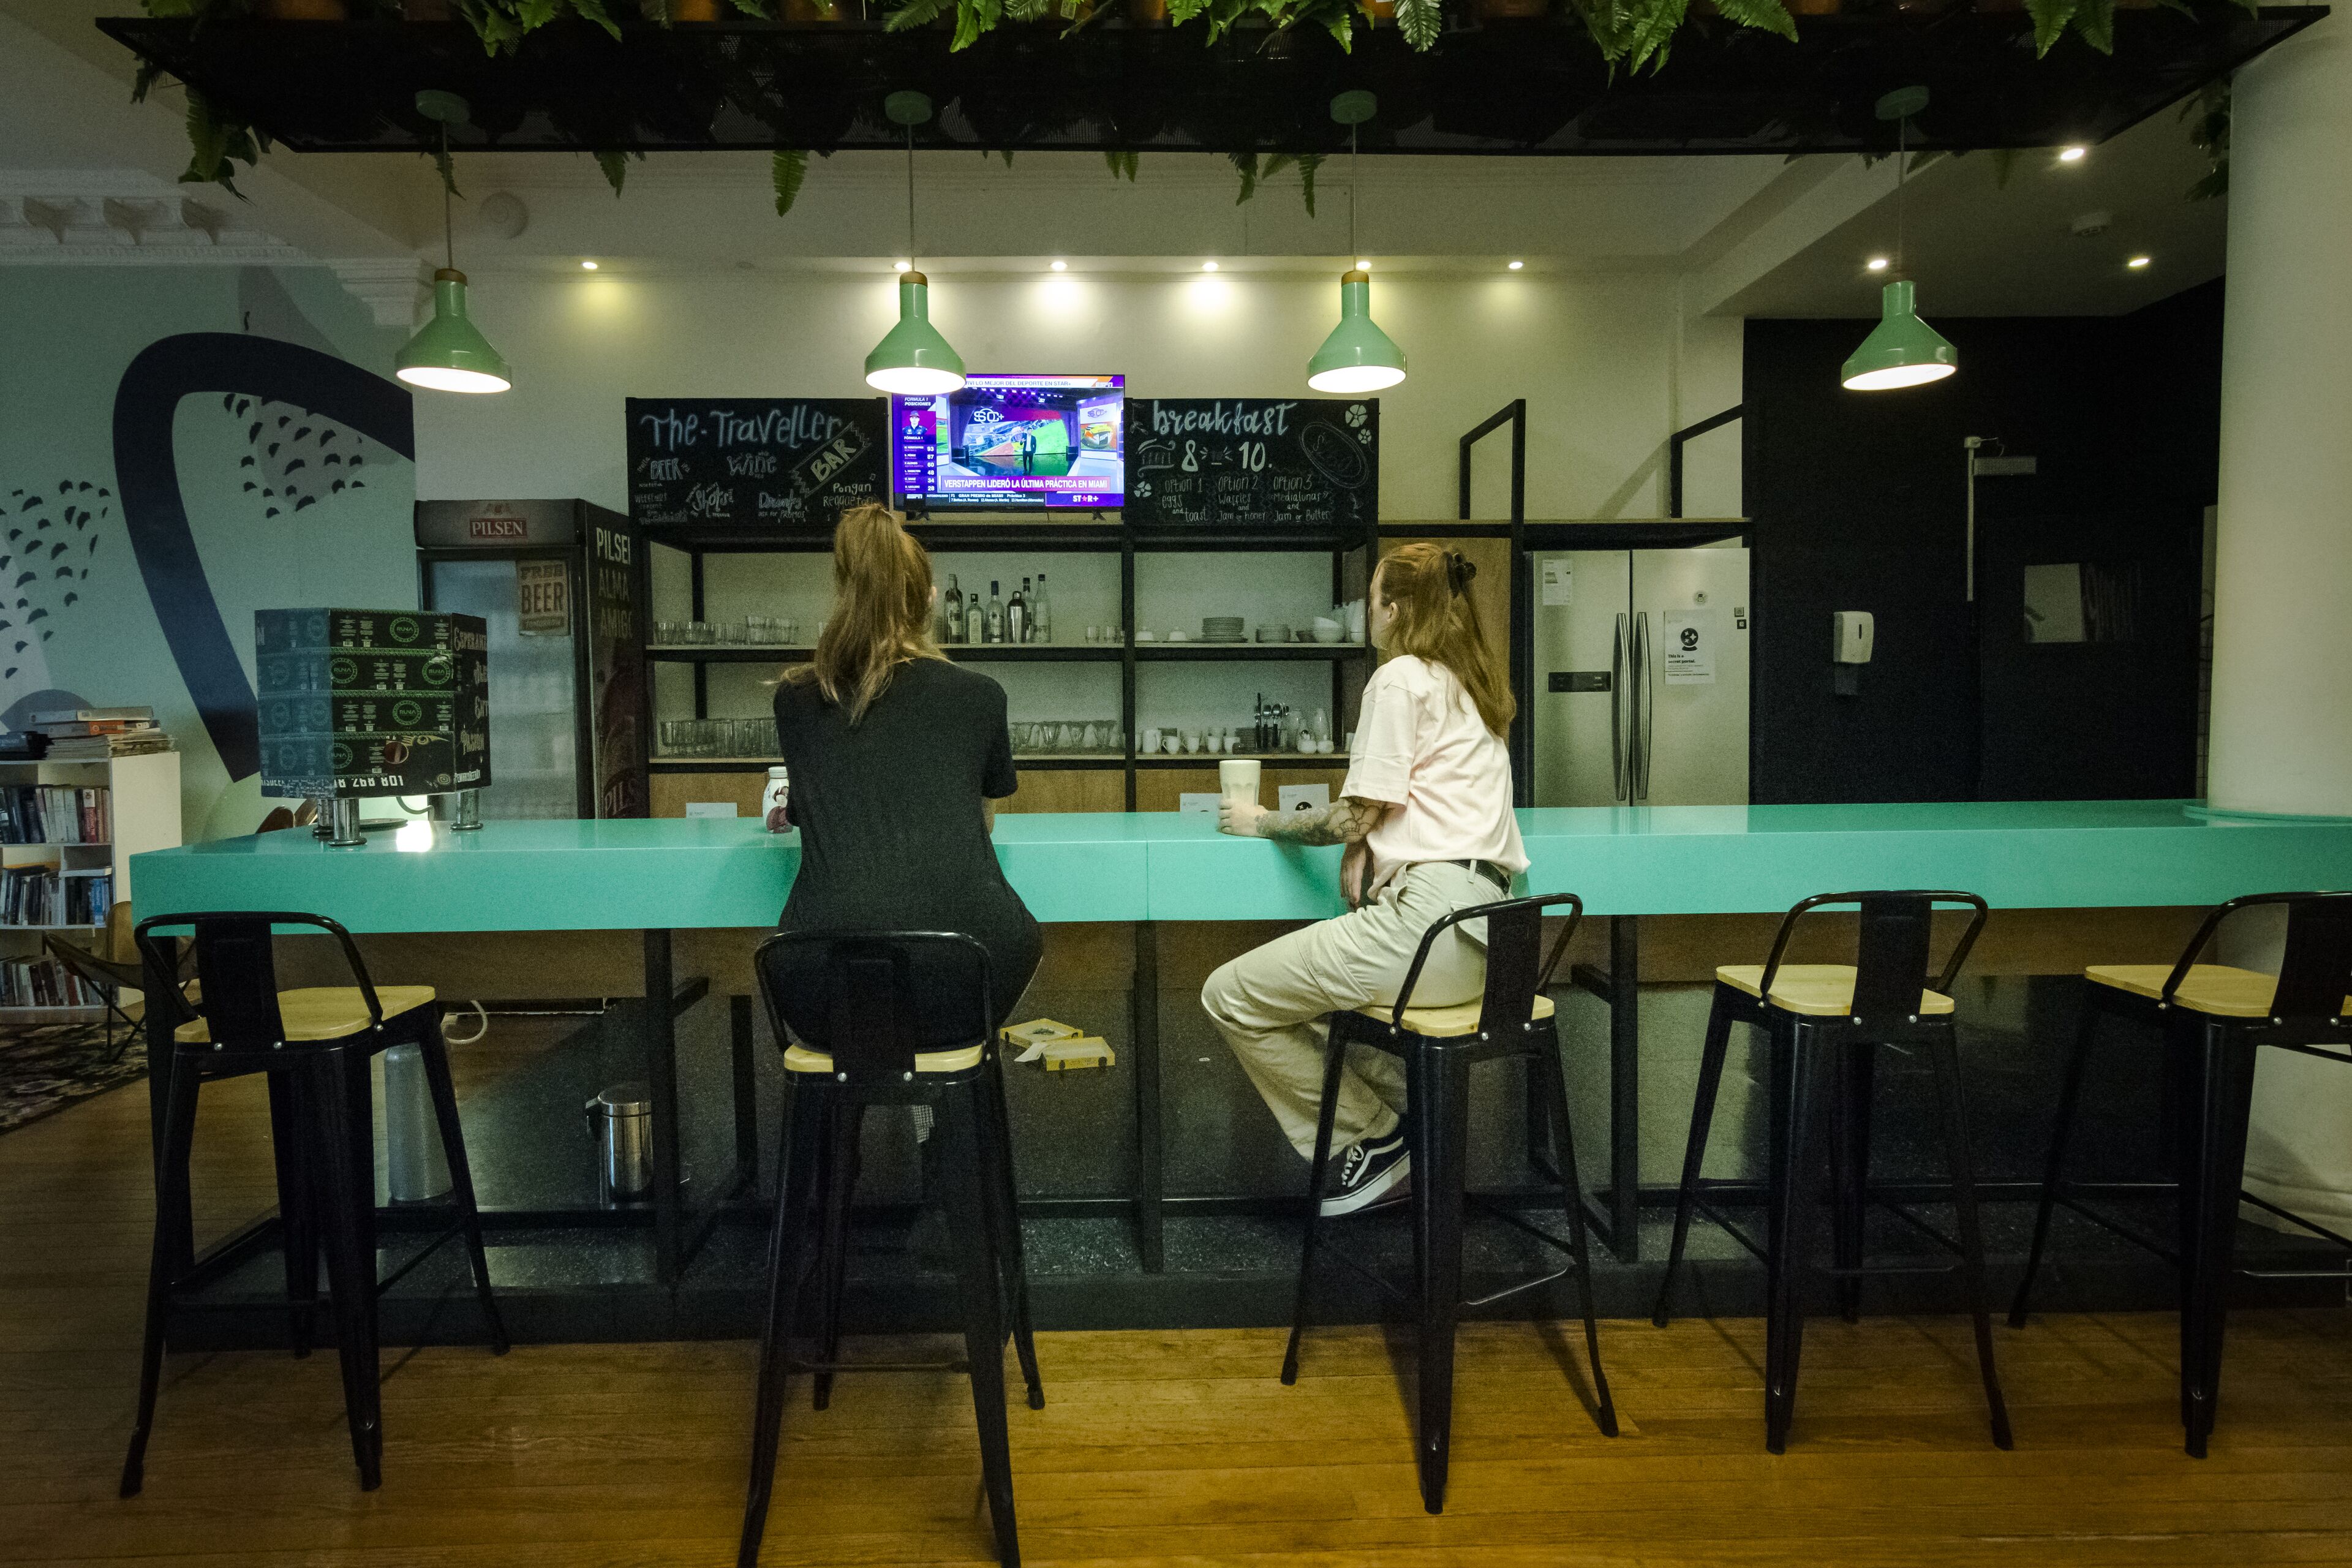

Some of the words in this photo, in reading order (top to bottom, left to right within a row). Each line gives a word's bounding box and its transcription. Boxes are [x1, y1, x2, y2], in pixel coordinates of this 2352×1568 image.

[1152, 400, 1297, 435] breakfast
[709, 405, 842, 448] Traveller
[810, 439, 857, 483] BAR
[1182, 440, 1199, 472] 8
[650, 458, 684, 481] BEER
[834, 483, 872, 495] Pongan
[944, 480, 986, 488] VERSTAPPEN
[987, 478, 1010, 488] LIDERÓ
[1011, 480, 1020, 488] LA
[1021, 478, 1044, 488] ÚLTIMA
[1046, 478, 1077, 488] PRÁCTICA
[1078, 480, 1087, 488] EN
[1088, 480, 1107, 488] MIAMI
[1251, 475, 1259, 490] 2
[1303, 474, 1313, 490] 3
[1162, 494, 1183, 508] eggs
[1287, 501, 1300, 510] and
[1273, 510, 1292, 522] Jam
[472, 521, 524, 535] PILSEN
[521, 564, 564, 579] FREE
[522, 581, 564, 614] BEER
